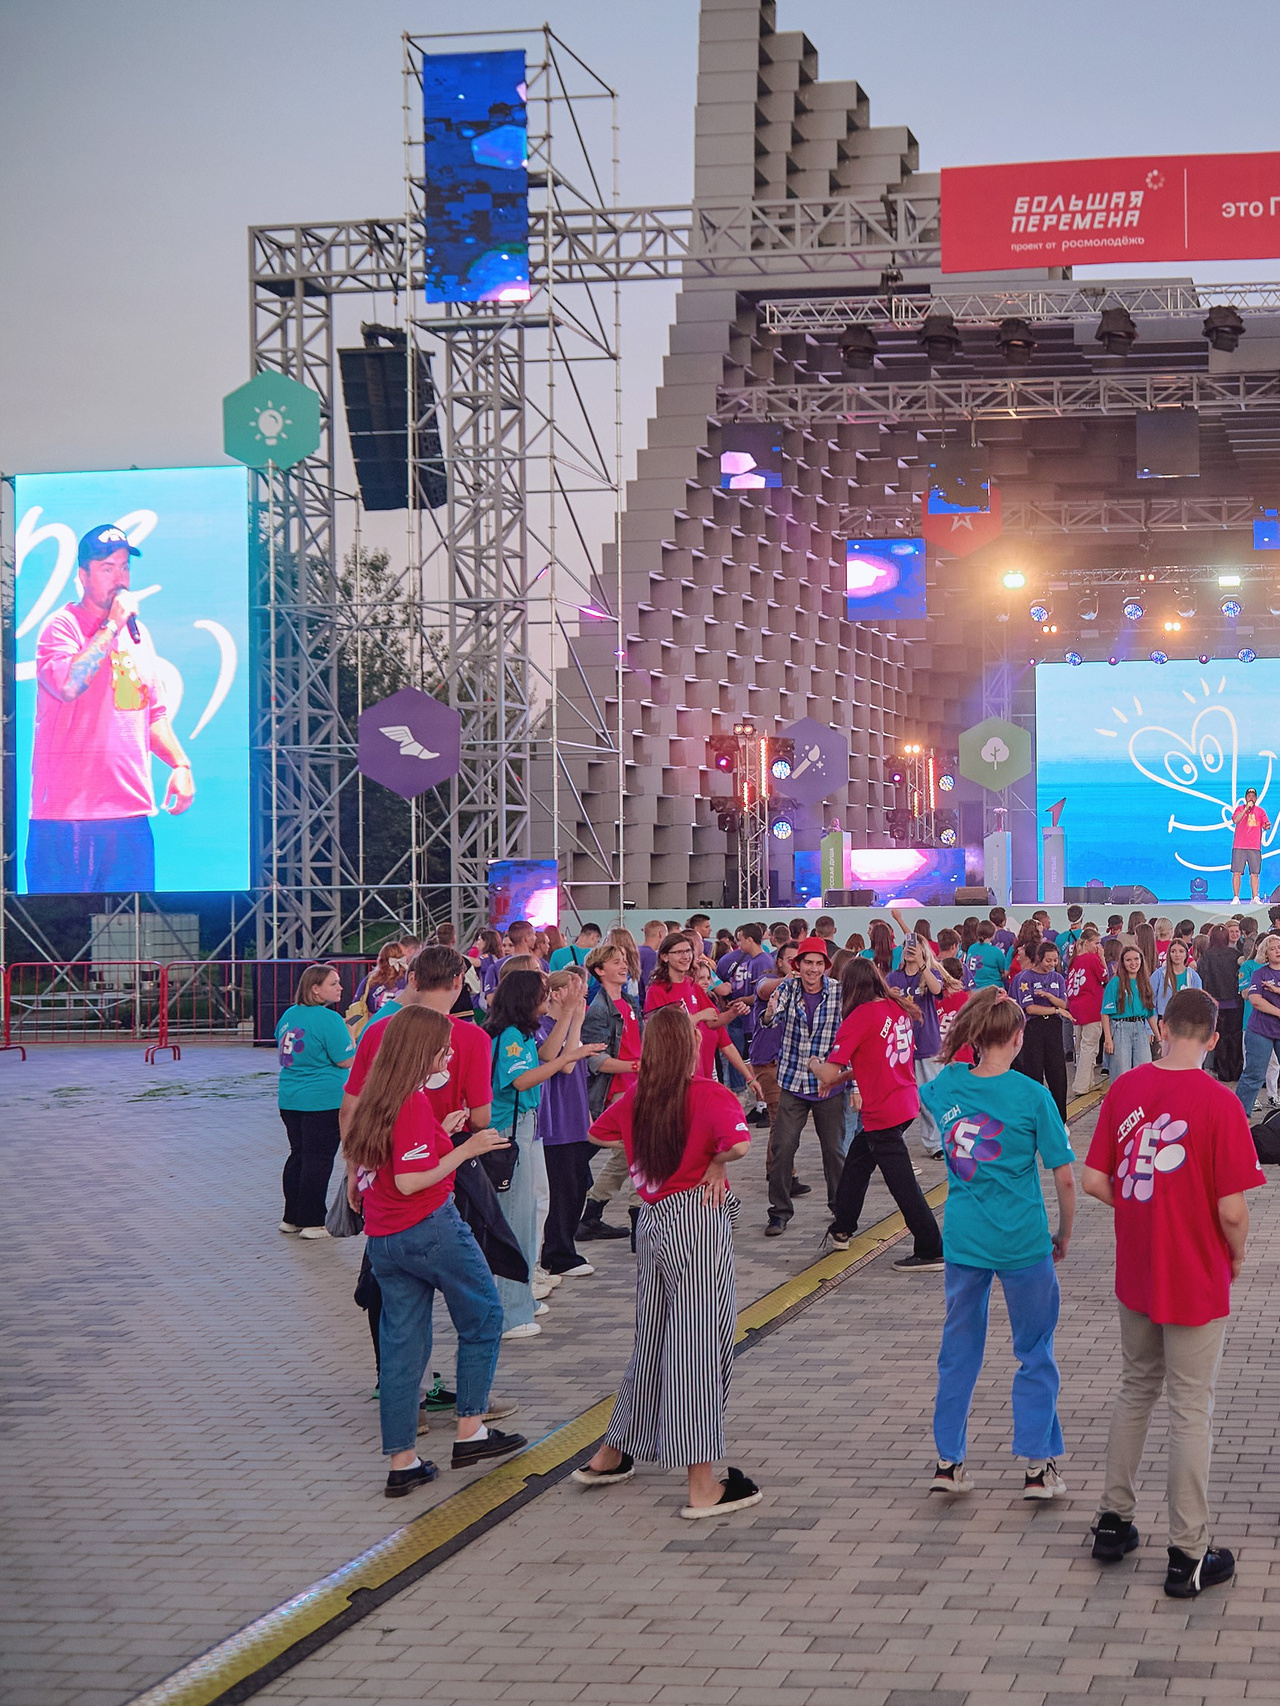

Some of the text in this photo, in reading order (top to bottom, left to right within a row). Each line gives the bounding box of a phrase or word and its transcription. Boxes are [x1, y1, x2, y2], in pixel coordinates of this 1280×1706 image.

[1014, 190, 1145, 214] БОЛЬШАЯ
[1221, 201, 1264, 218] это
[1011, 209, 1141, 234] ПЕРЕМЕНА
[1010, 235, 1146, 252] проект от росмолодёжь
[283, 1031, 296, 1055] 5
[895, 1024, 909, 1050] 5
[954, 1121, 981, 1159] 5
[1134, 1128, 1162, 1174] 5
